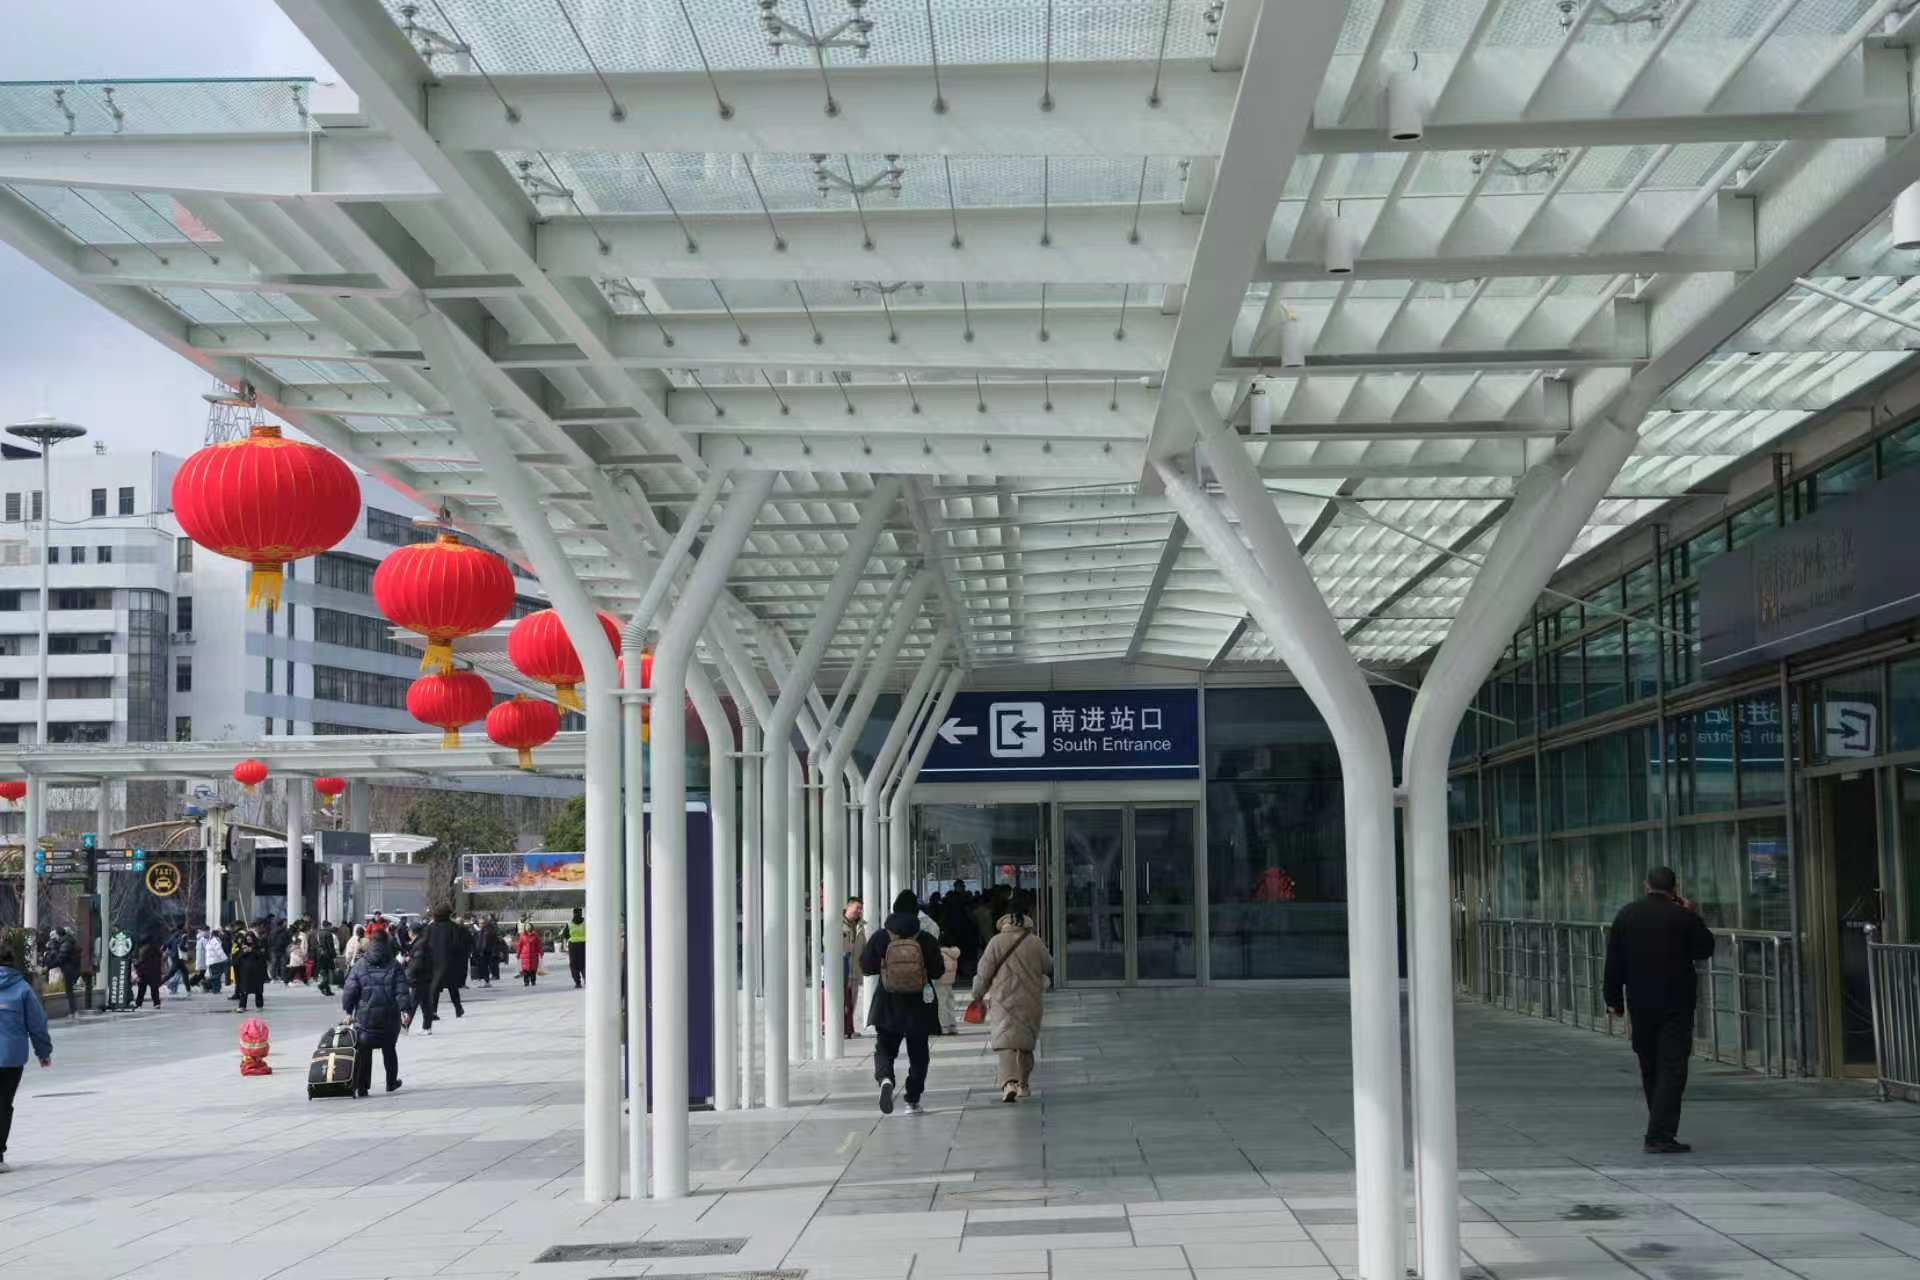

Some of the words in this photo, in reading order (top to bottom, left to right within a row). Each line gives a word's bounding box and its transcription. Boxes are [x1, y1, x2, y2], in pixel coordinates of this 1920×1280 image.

[1052, 705, 1162, 733] 南进站口
[1052, 737, 1097, 752] South
[1103, 737, 1171, 751] Entrance
